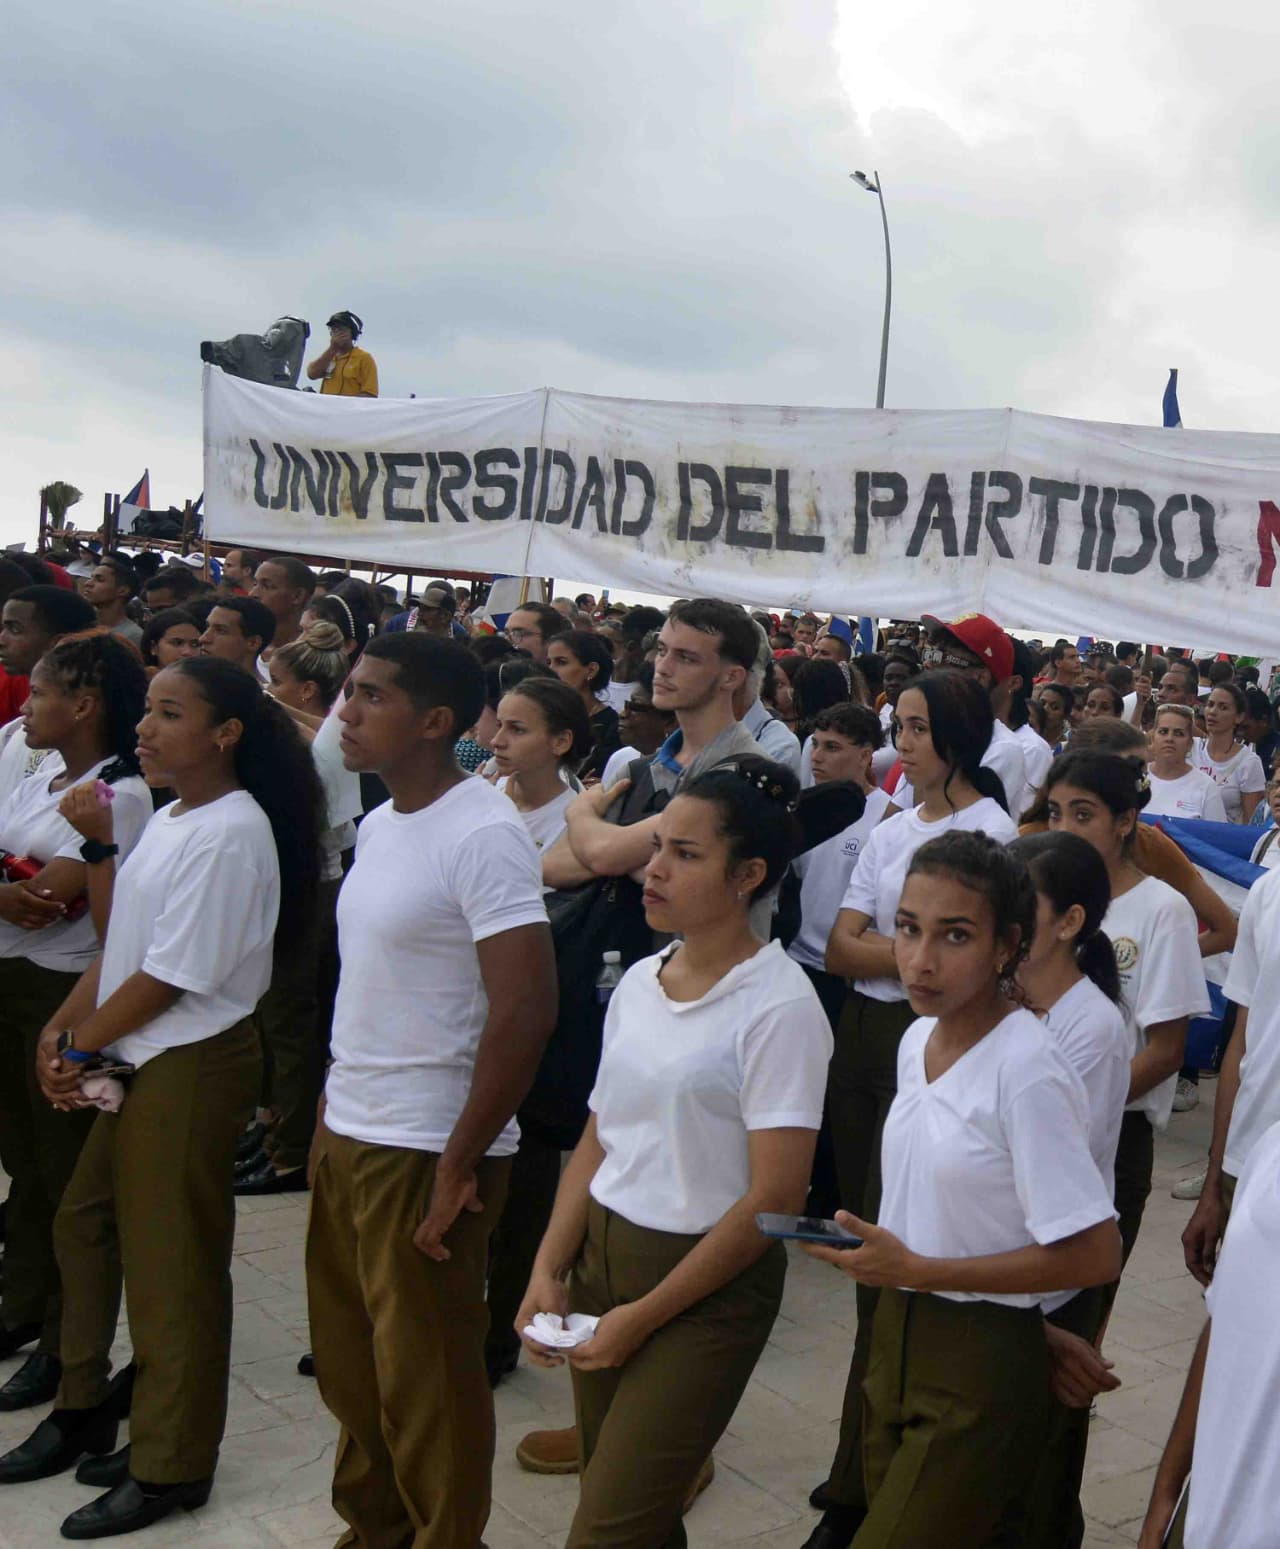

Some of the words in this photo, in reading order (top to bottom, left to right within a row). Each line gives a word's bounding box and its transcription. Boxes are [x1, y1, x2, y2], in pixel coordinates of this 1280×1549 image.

[249, 438, 657, 537] UNIVERSIDAD
[676, 461, 826, 553] DEL
[852, 470, 1220, 579] PARTIDO
